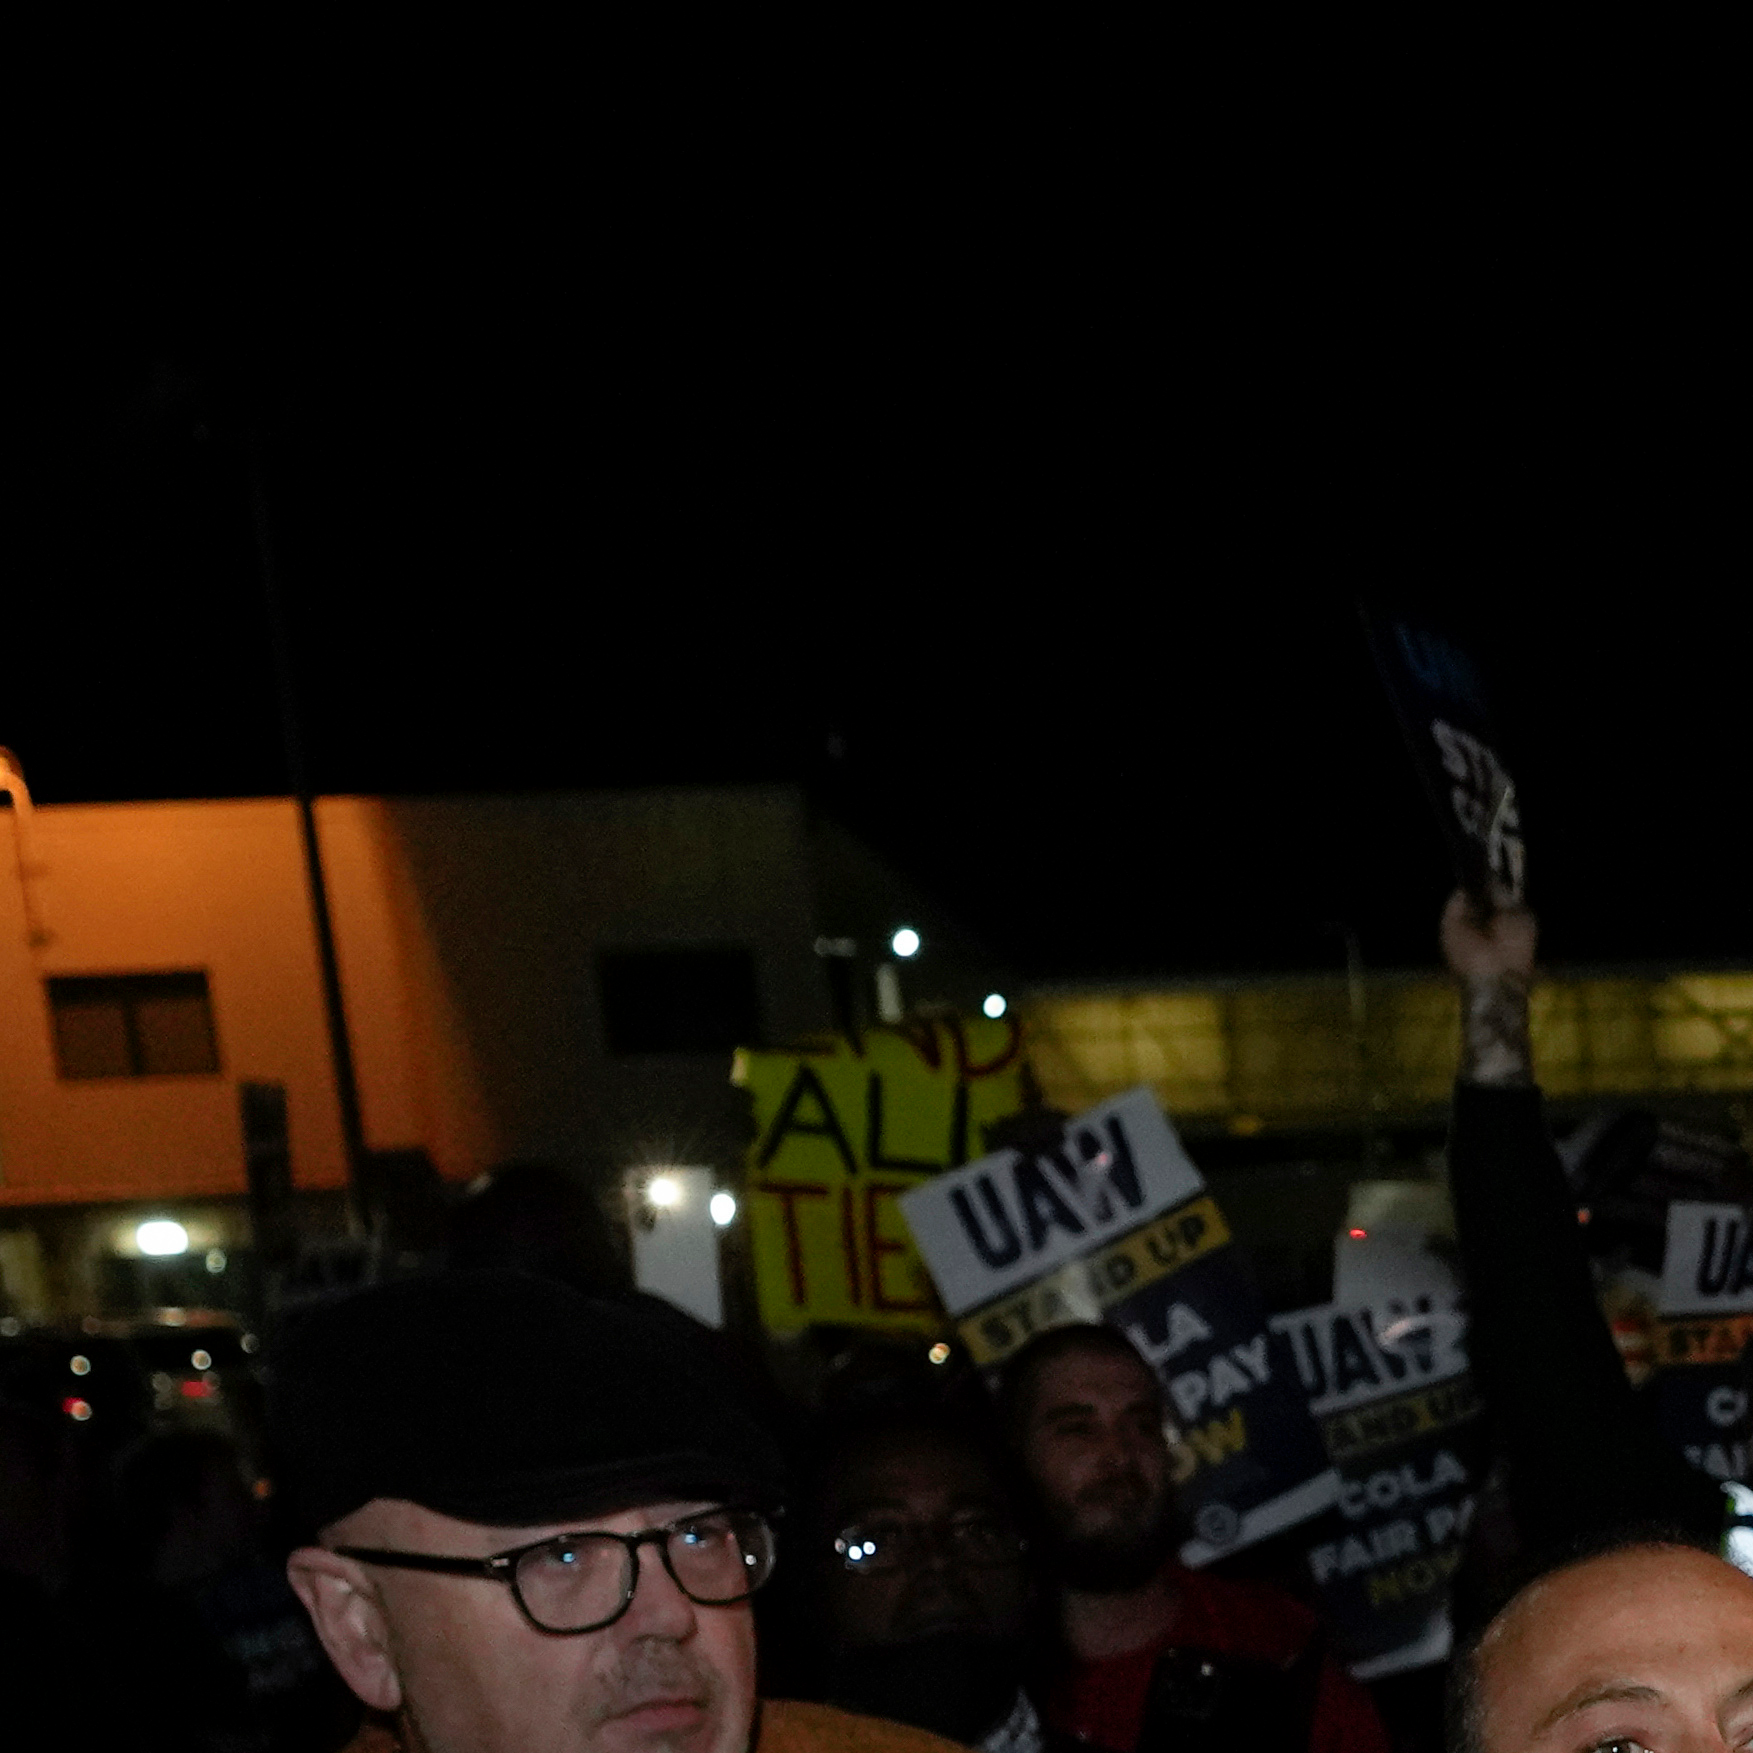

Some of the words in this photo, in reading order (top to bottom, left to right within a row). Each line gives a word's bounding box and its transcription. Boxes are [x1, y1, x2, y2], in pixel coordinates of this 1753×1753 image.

[951, 1116, 1145, 1269] UAW
[758, 1180, 942, 1312] TIE
[1126, 1300, 1213, 1368] LA
[1169, 1331, 1272, 1421] PAY
[1338, 1450, 1468, 1521] COLA
